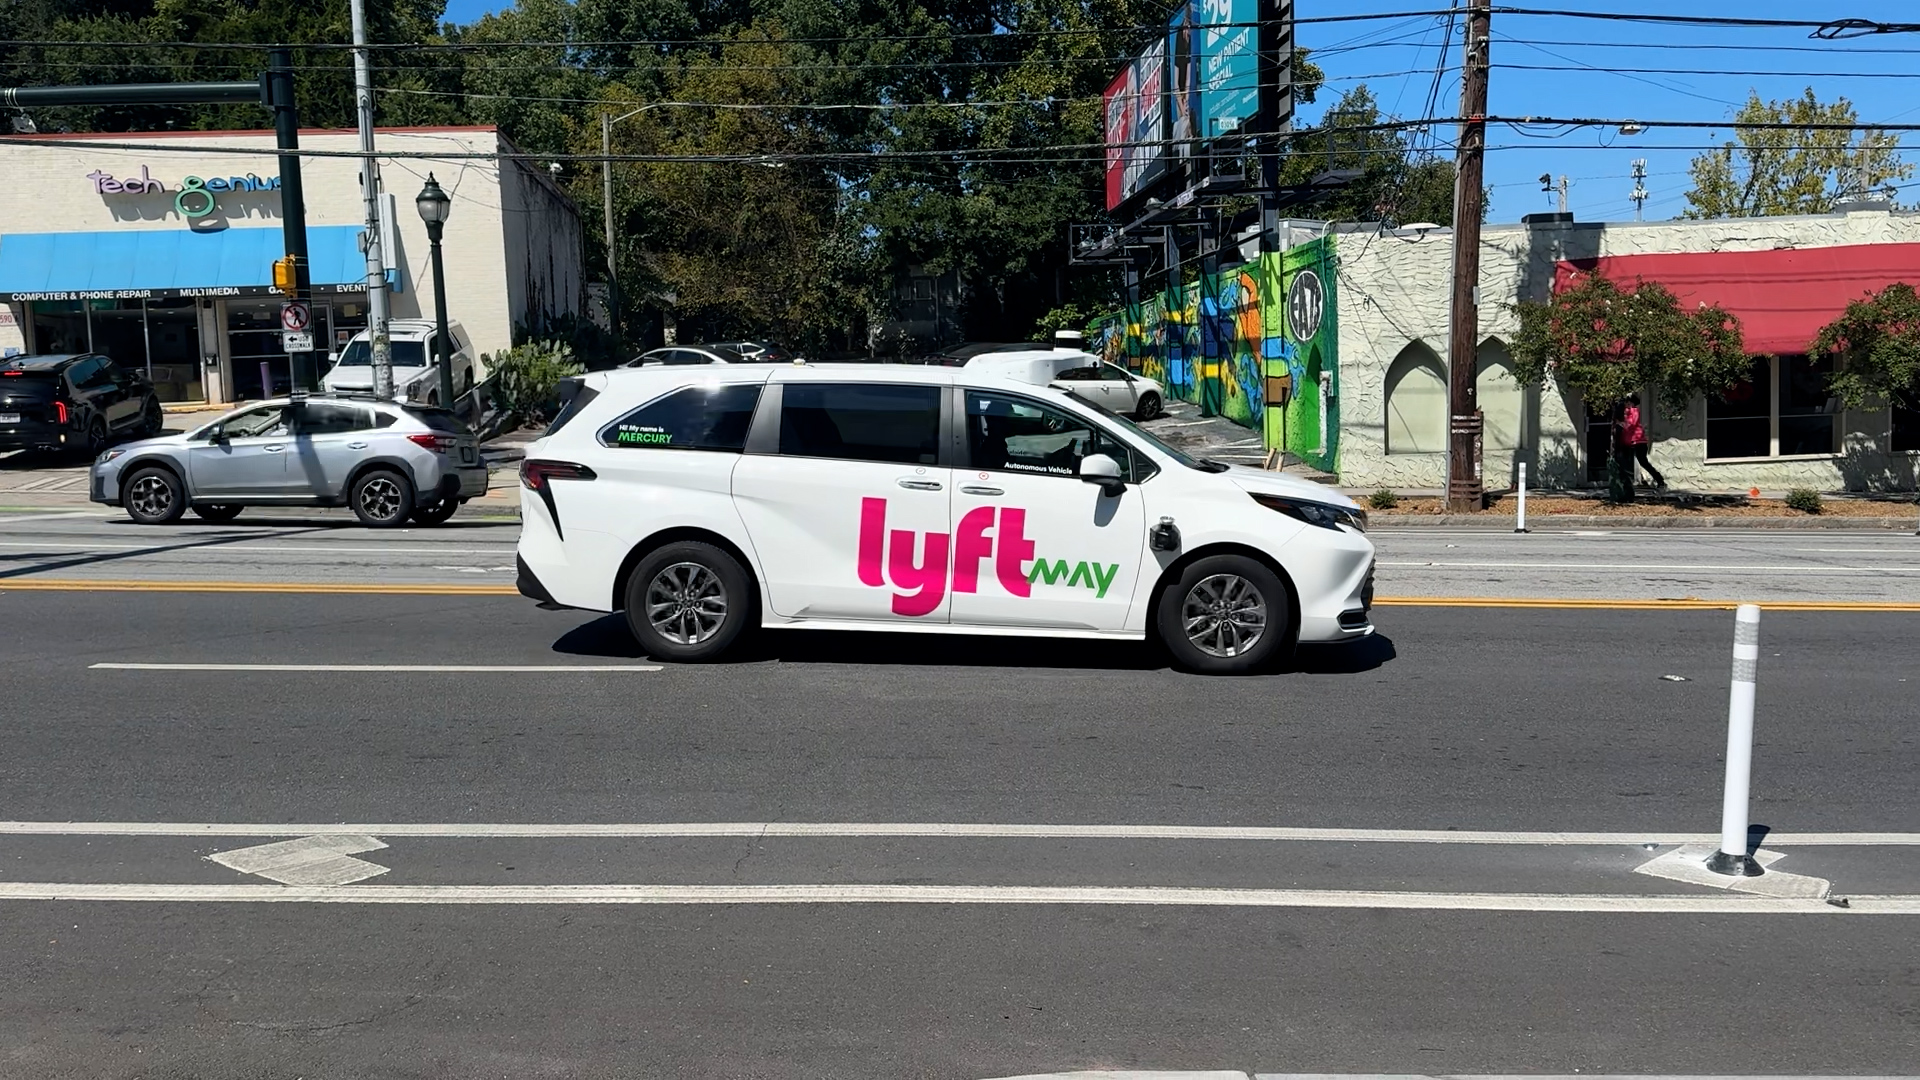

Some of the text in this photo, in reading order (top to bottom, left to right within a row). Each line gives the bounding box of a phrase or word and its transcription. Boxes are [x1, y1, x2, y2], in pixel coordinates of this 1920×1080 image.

[1208, 26, 1249, 76] NEW PATIENT
[1208, 63, 1233, 94] SPECIAL
[12, 292, 67, 301] COMPUTER
[70, 292, 77, 300] &
[80, 291, 114, 300] PHONE
[117, 289, 151, 299] REPAIR
[180, 287, 240, 297] MULTIMEDIA
[618, 432, 672, 443] MERCURY
[1004, 461, 1073, 475] Autonomous Vehicle
[857, 496, 1035, 617] lyft
